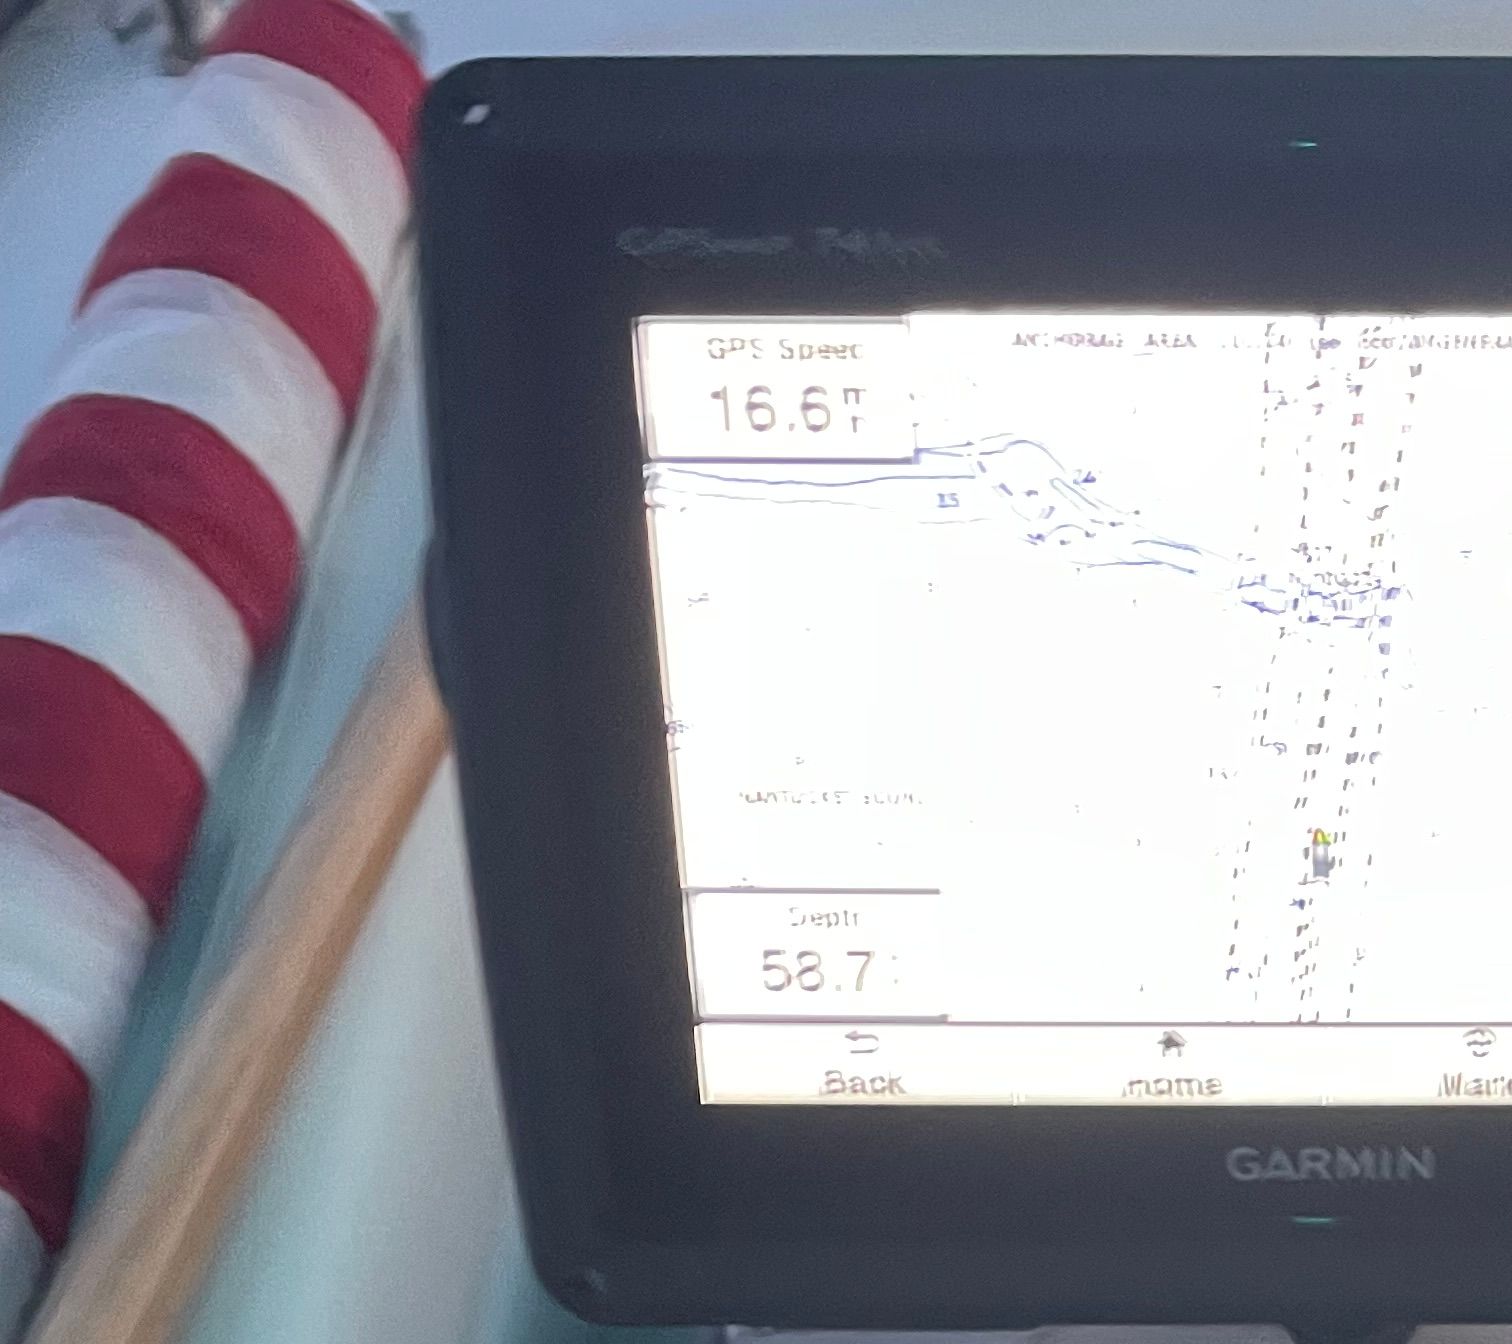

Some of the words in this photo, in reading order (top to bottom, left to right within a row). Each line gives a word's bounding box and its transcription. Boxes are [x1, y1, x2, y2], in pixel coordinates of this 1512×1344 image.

[710, 385, 832, 432] 16.6
[763, 949, 876, 992] 58.7
[1225, 1146, 1437, 1181] GARMIN
